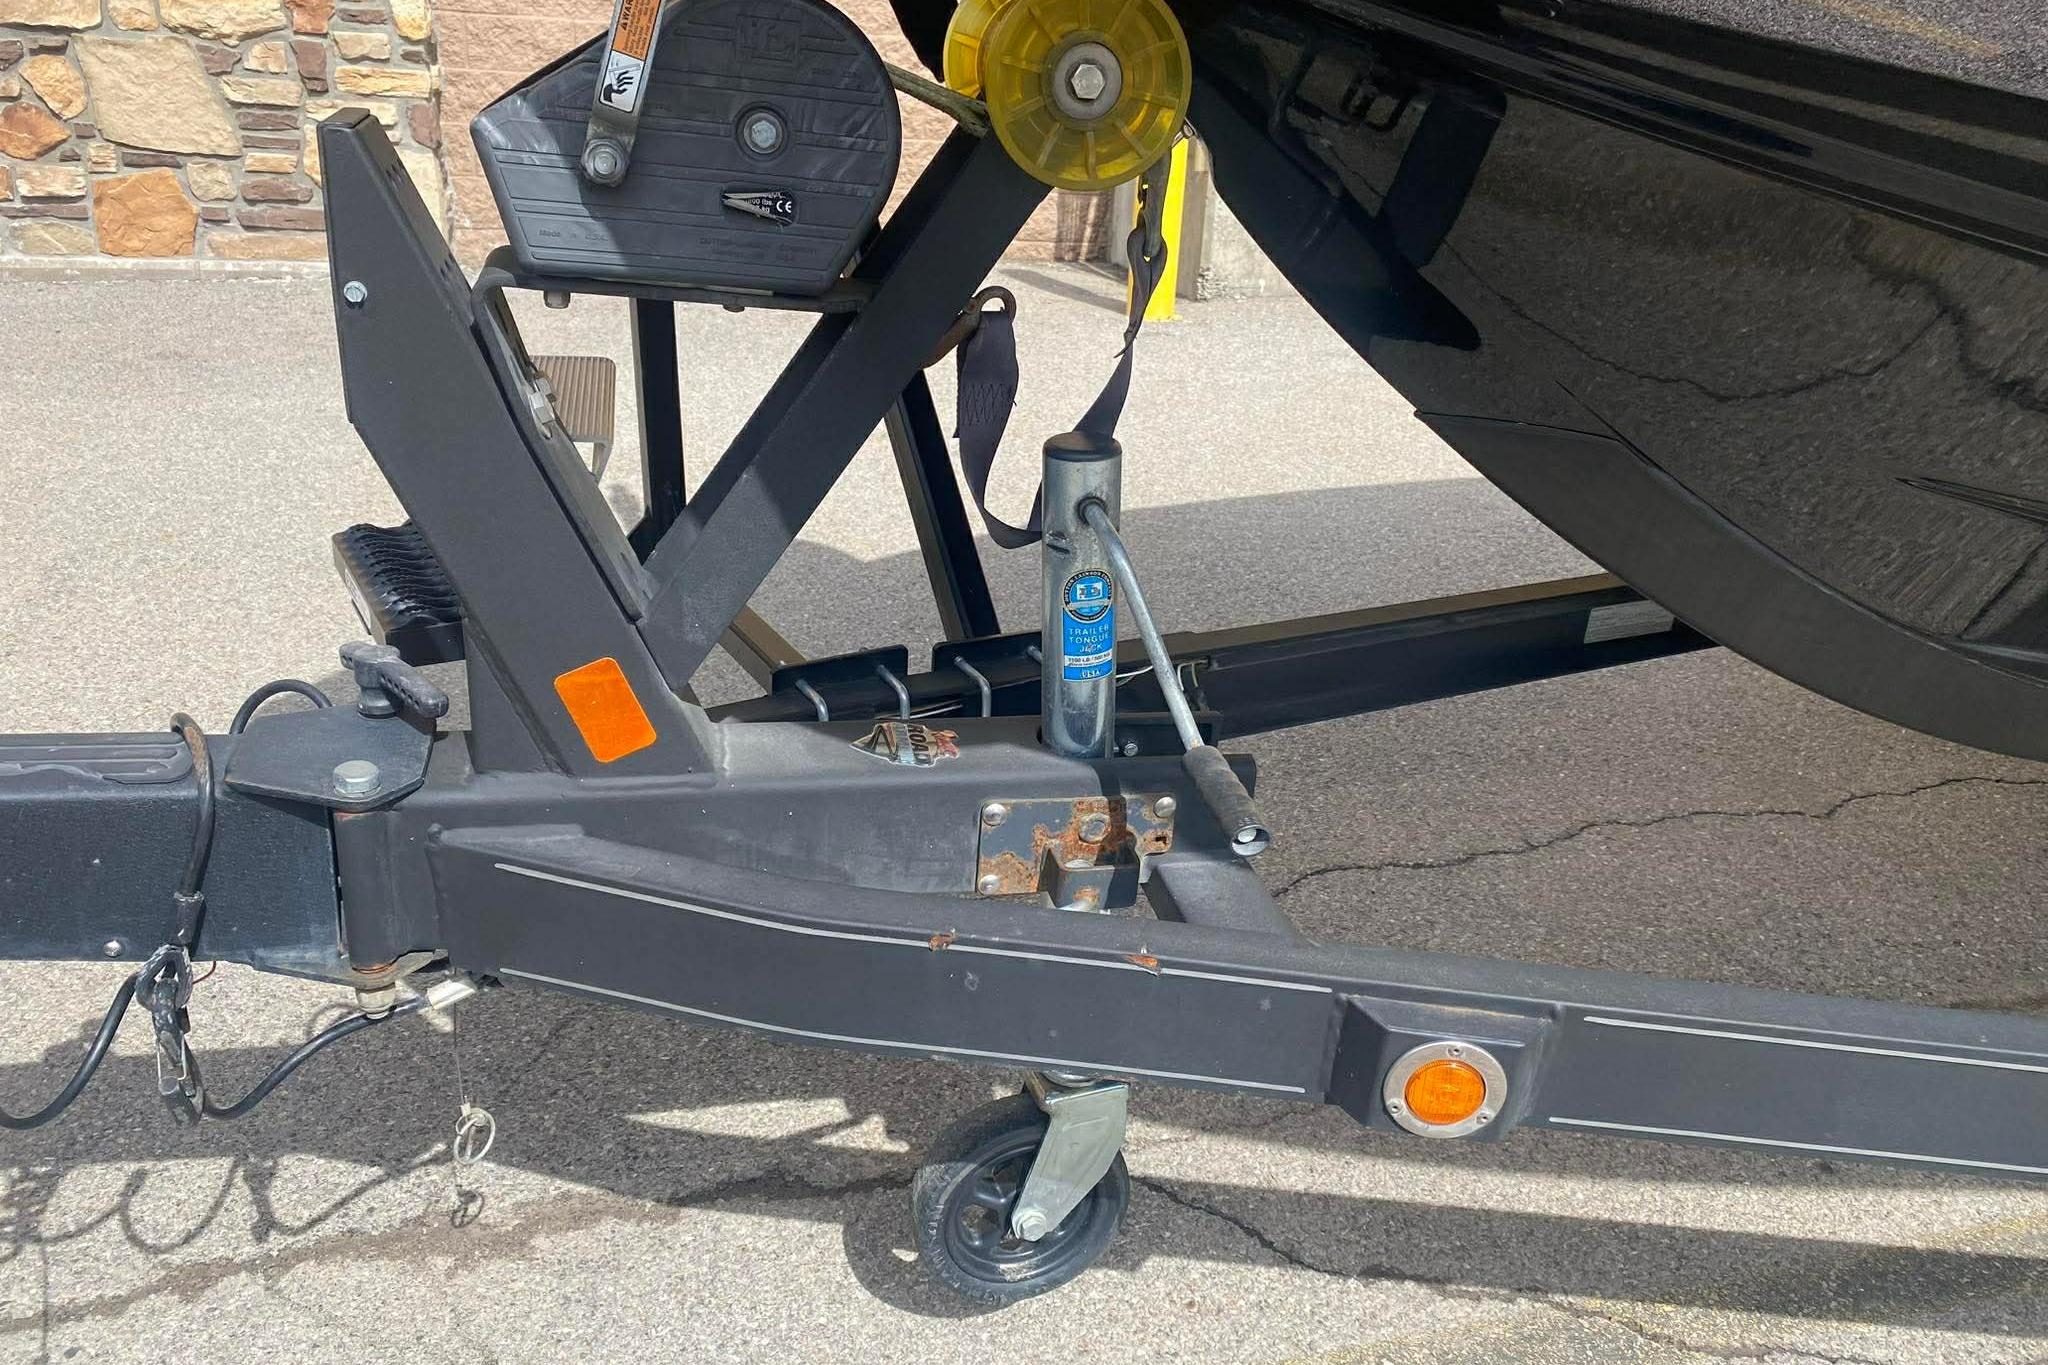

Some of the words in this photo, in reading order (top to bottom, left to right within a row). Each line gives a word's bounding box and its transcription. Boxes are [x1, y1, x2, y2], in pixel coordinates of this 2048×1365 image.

[776, 200, 792, 213] CE
[1069, 624, 1109, 636] TRAILER
[1069, 633, 1109, 644] TONGUE
[1080, 644, 1102, 653] JACK
